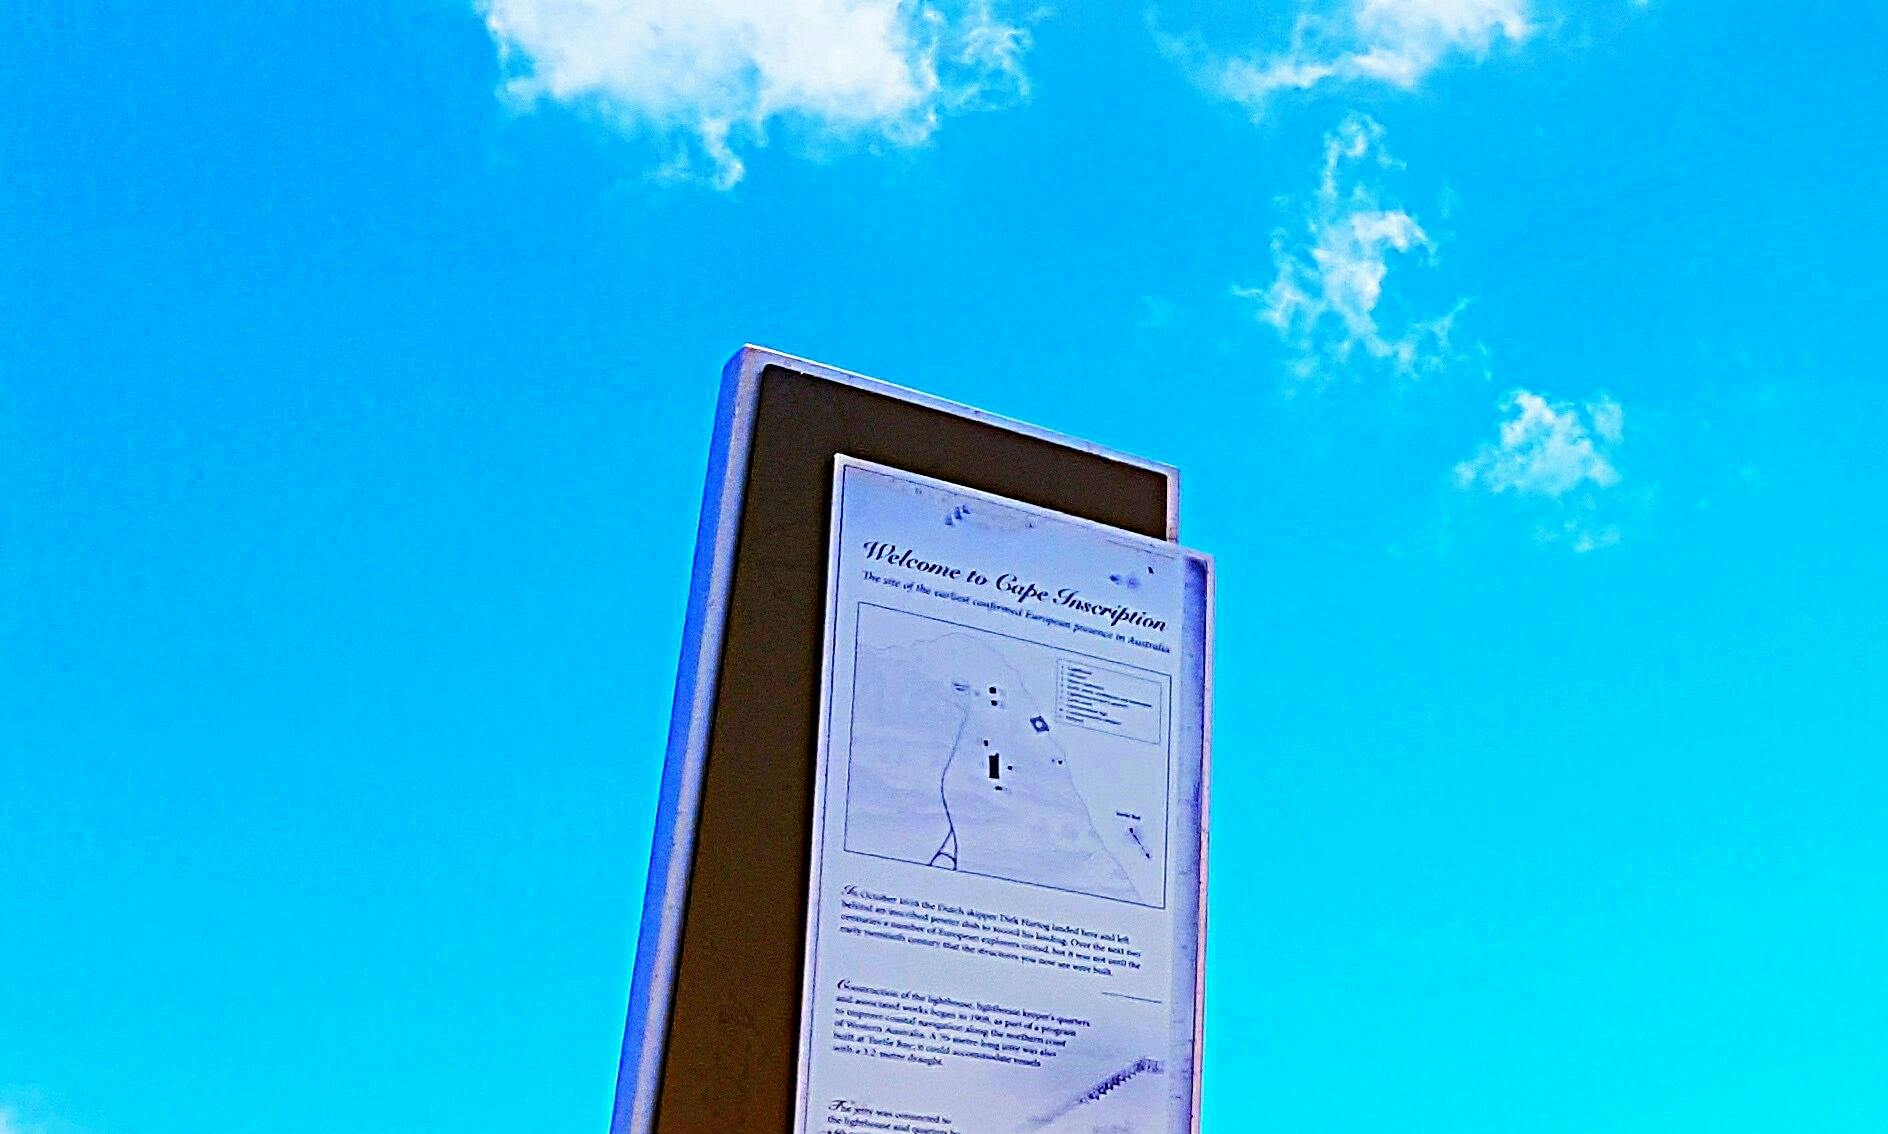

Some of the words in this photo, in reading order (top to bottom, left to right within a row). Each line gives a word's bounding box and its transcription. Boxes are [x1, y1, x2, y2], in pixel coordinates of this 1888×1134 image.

[863, 541, 960, 579] Welcome
[966, 569, 987, 586] to
[996, 572, 1049, 602] Cape
[1053, 588, 1167, 632] Inscription
[865, 569, 879, 580] The
[883, 575, 900, 585] site
[904, 580, 913, 589] of
[918, 583, 931, 593] the
[973, 599, 1022, 616] confirmed
[1026, 610, 1071, 628] European
[1117, 632, 1125, 641] in
[1129, 635, 1169, 652] Australia
